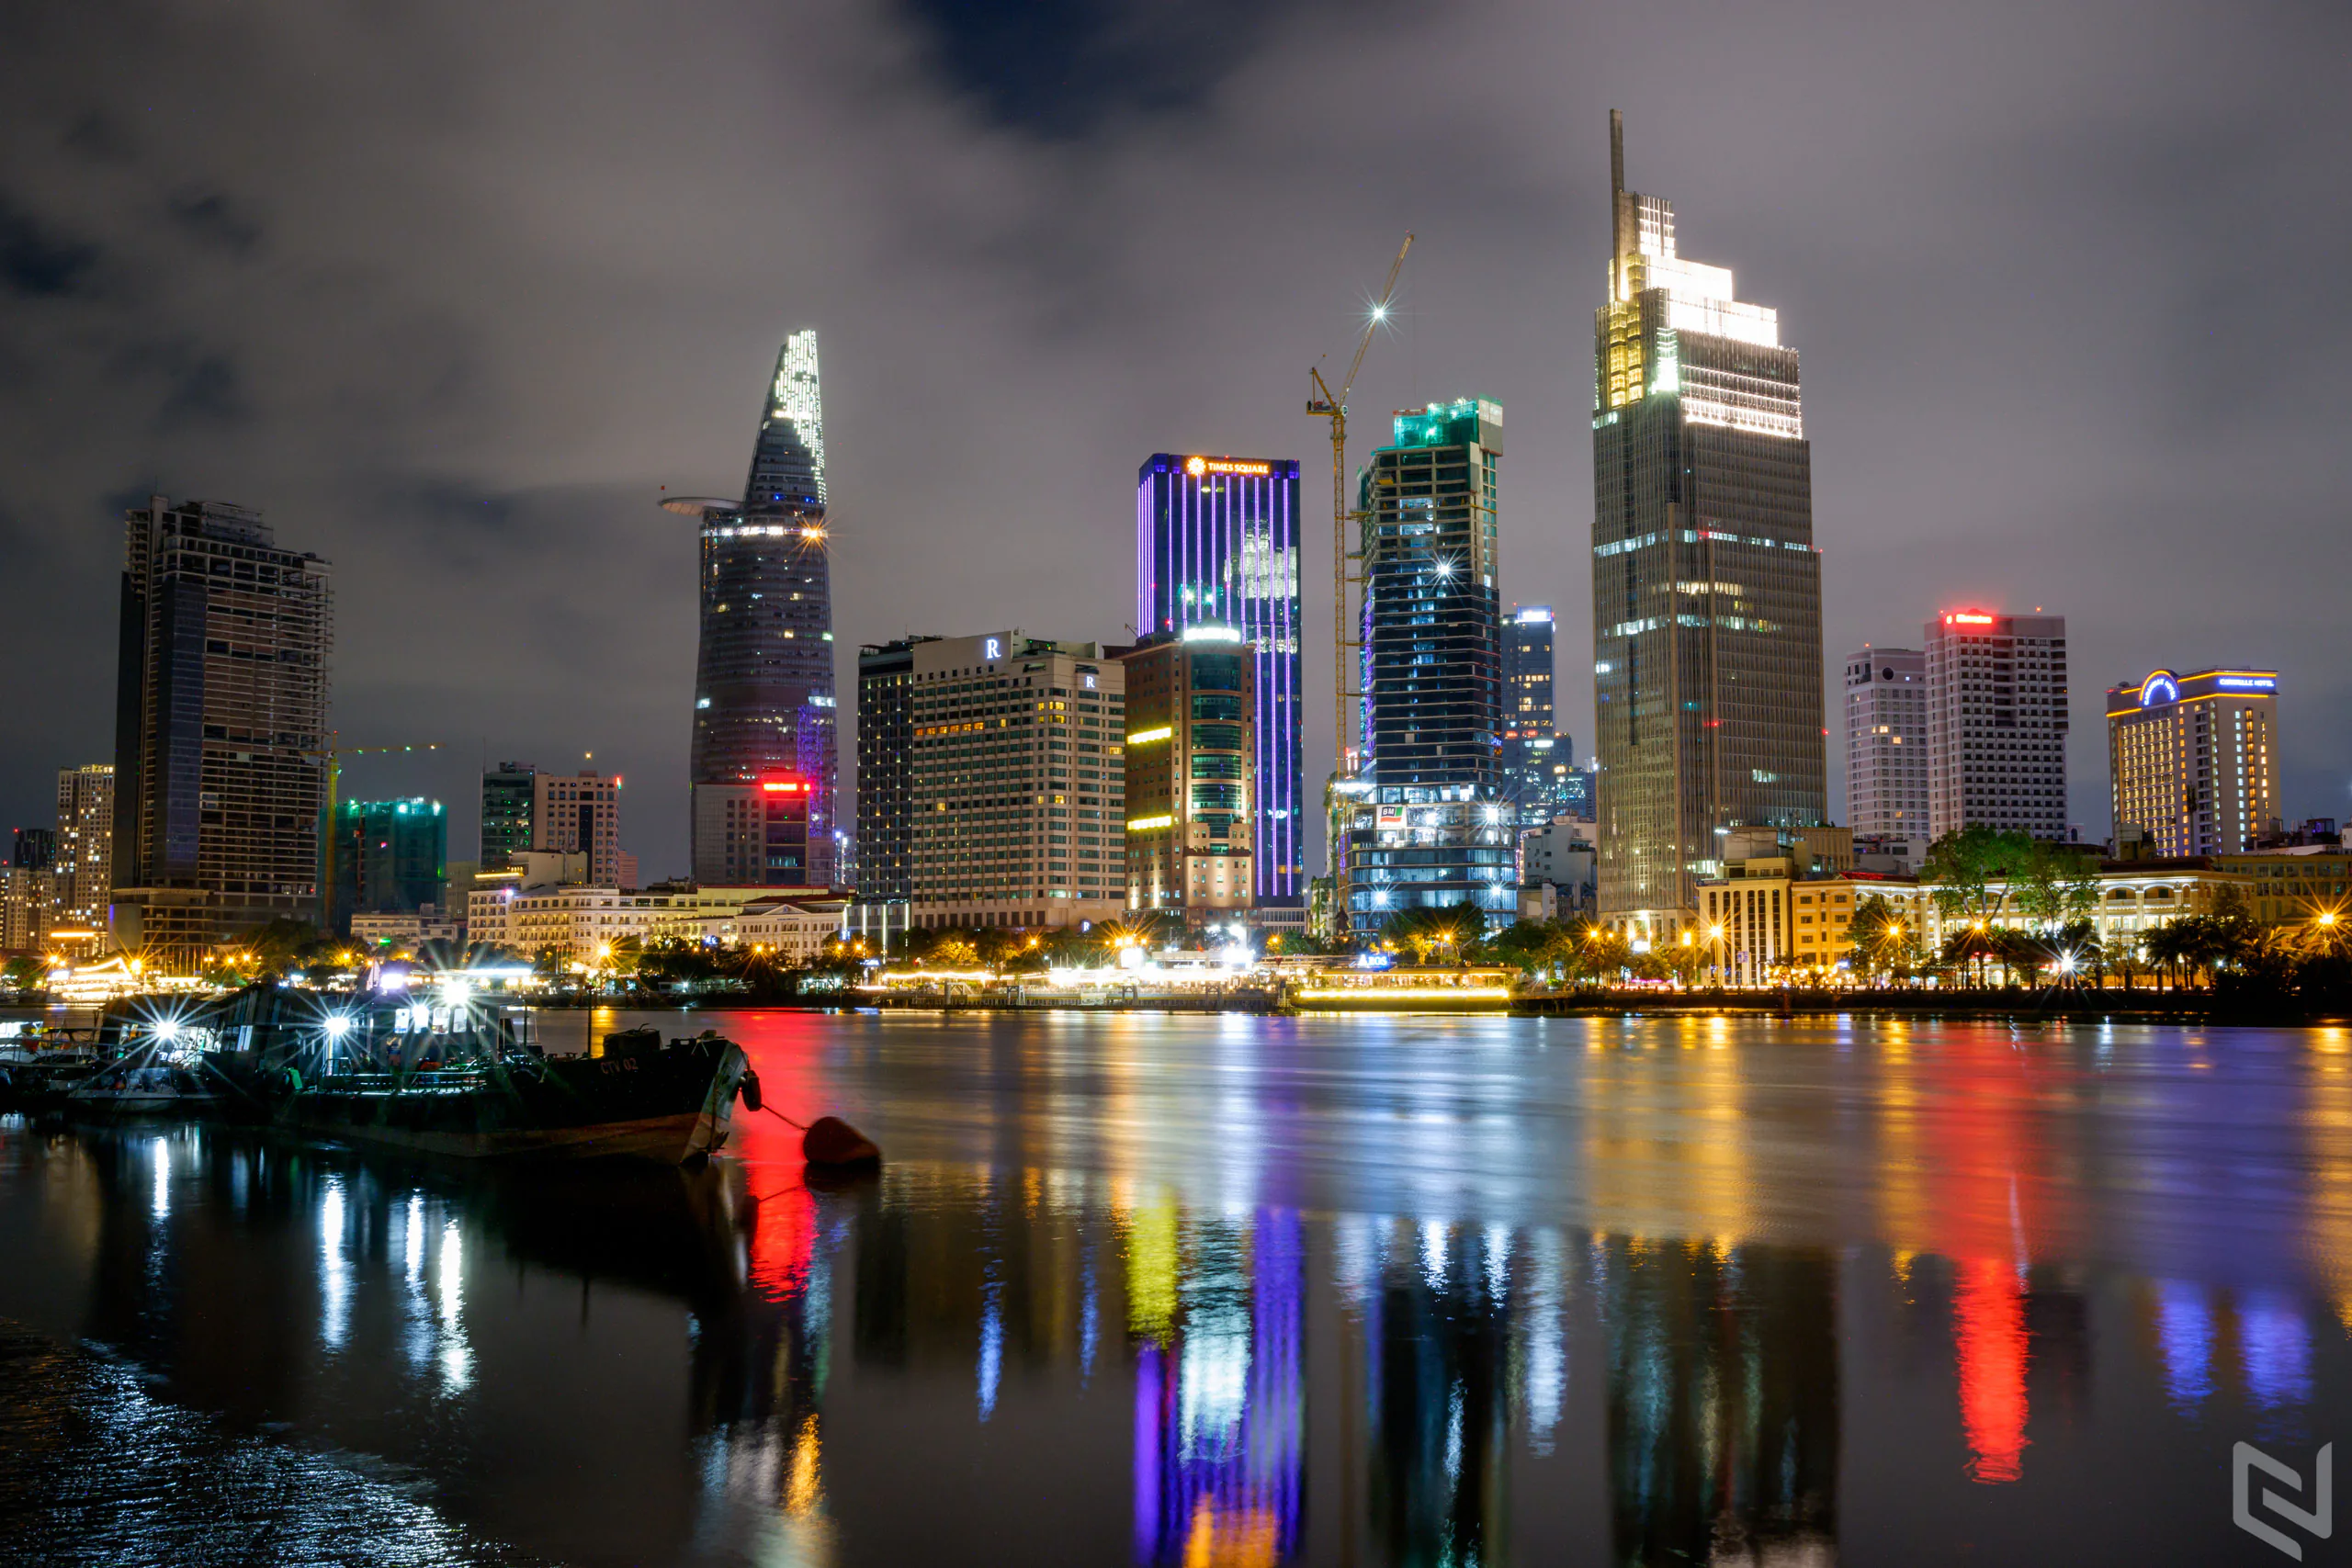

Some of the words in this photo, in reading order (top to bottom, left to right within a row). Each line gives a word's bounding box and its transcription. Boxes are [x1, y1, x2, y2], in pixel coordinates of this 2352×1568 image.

[1208, 462, 1233, 471] TIMES
[1234, 464, 1269, 474] SQUARE
[987, 639, 1001, 659] R
[1086, 676, 1095, 687] R
